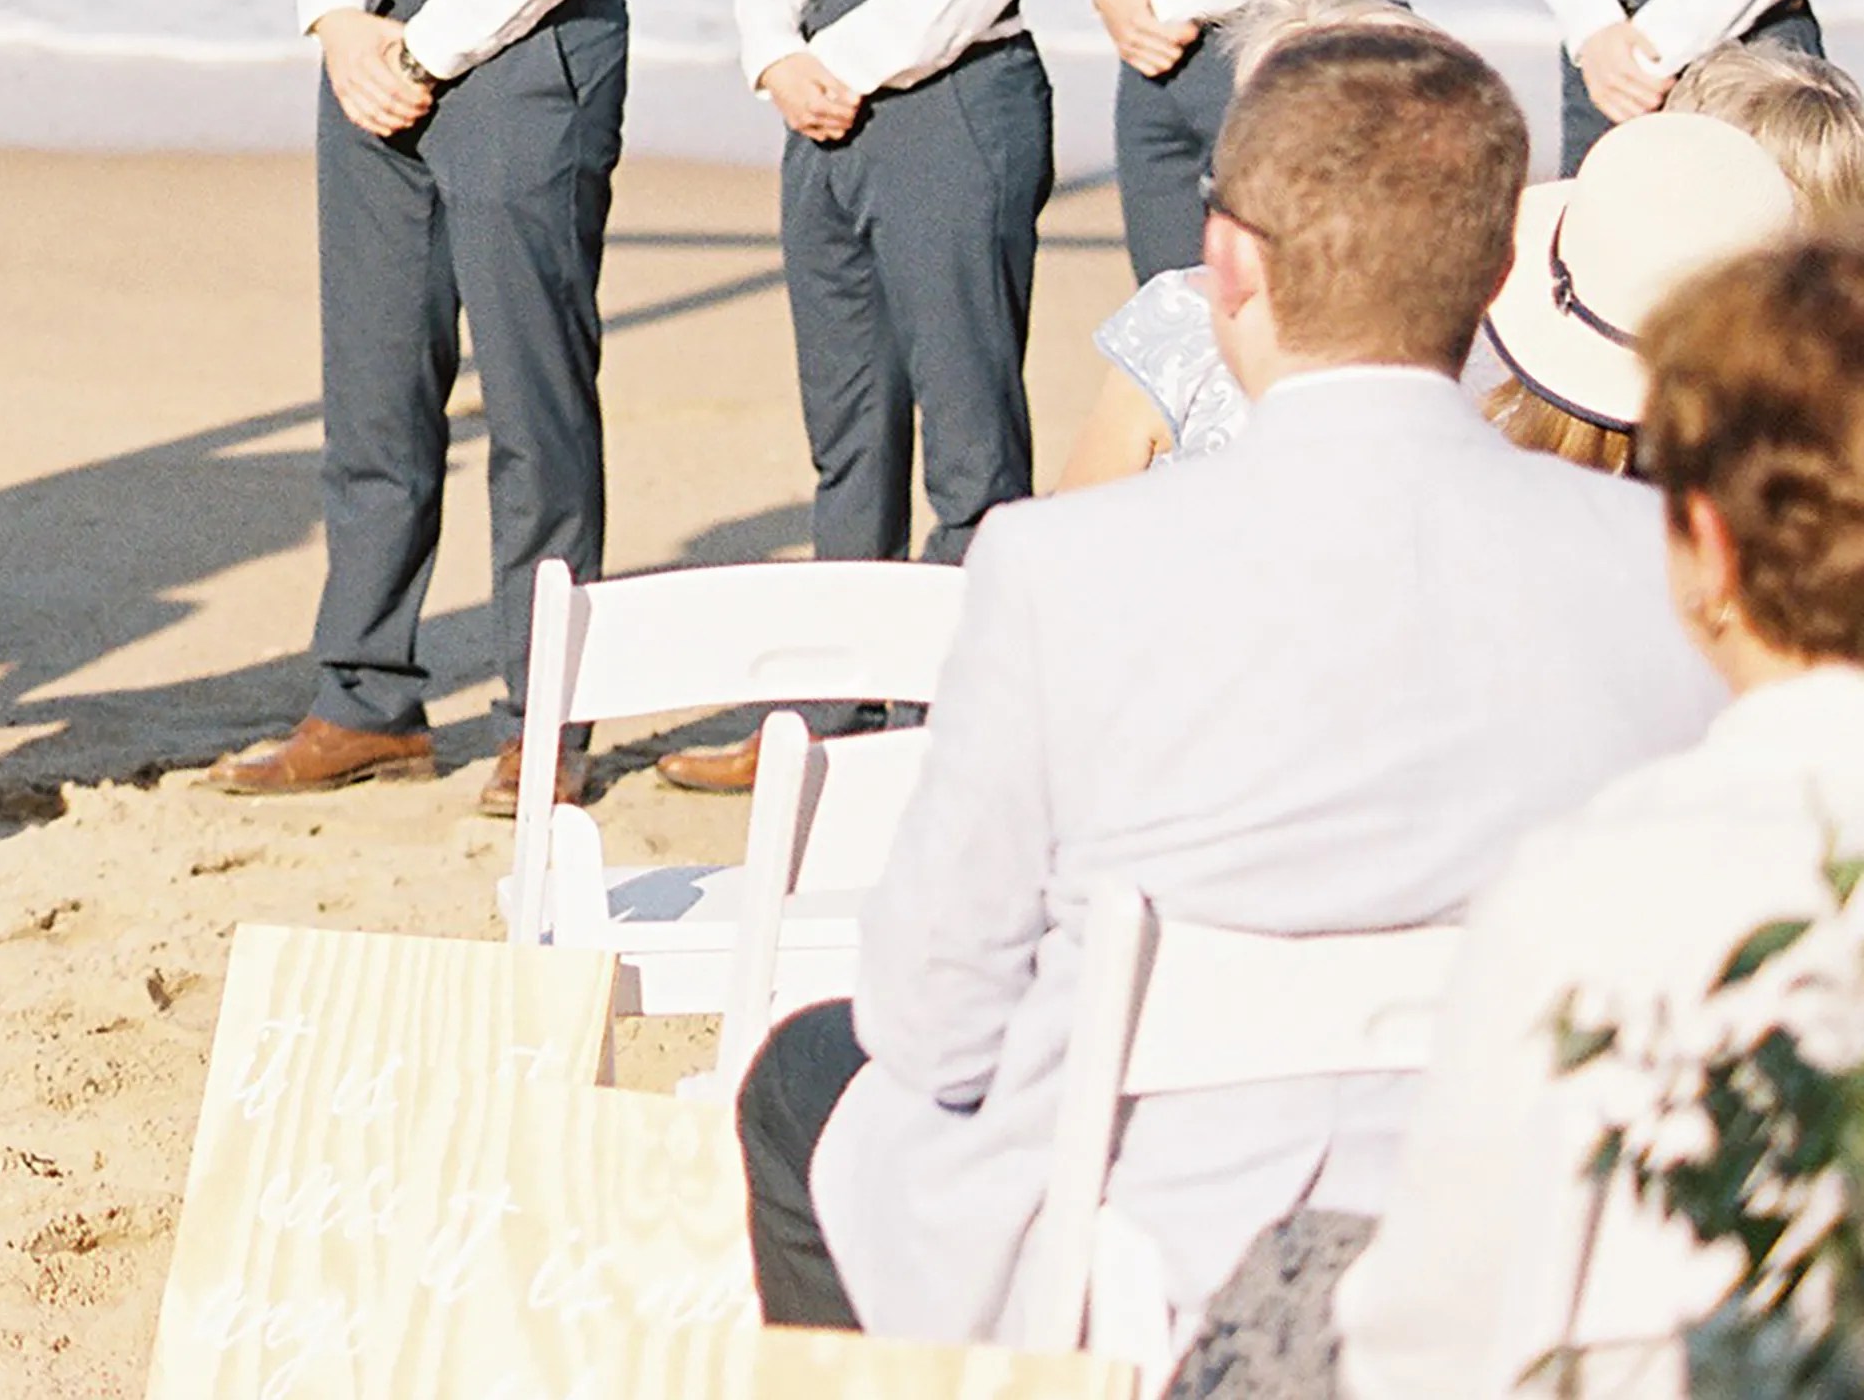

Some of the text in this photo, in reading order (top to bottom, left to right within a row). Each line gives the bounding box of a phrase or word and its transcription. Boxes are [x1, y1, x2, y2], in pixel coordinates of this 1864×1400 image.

[232, 1014, 316, 1121] it
[332, 1042, 402, 1127] is
[421, 1184, 521, 1304] it
[528, 1226, 614, 1324] is
